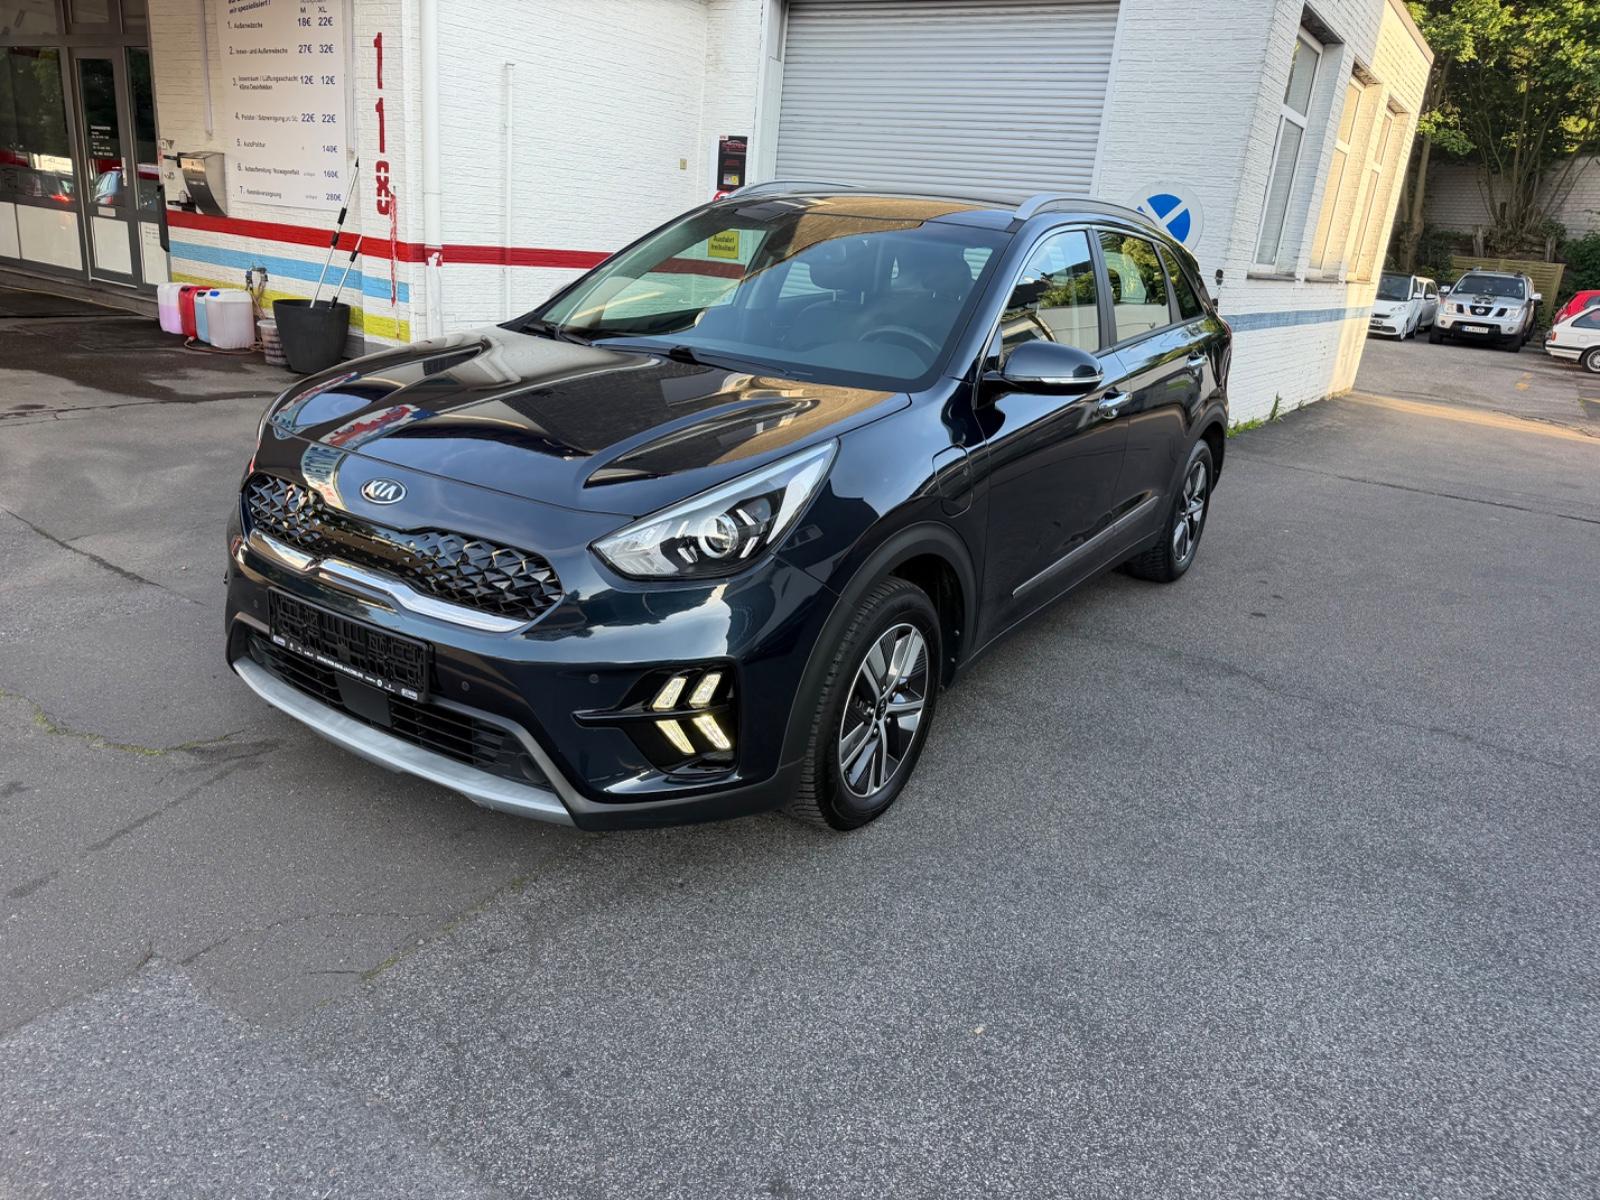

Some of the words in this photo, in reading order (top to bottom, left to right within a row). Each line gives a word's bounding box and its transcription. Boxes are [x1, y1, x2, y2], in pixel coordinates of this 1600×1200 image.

[297, 17, 311, 27] 18€
[318, 16, 333, 27] 22€
[298, 44, 312, 54] 27€
[319, 44, 334, 54] 32€
[300, 75, 314, 85] 12€
[321, 75, 335, 85] 12€
[301, 113, 315, 123] 22€
[321, 113, 336, 123] 22€
[322, 144, 338, 153] 140€
[365, 480, 397, 500] KIA
